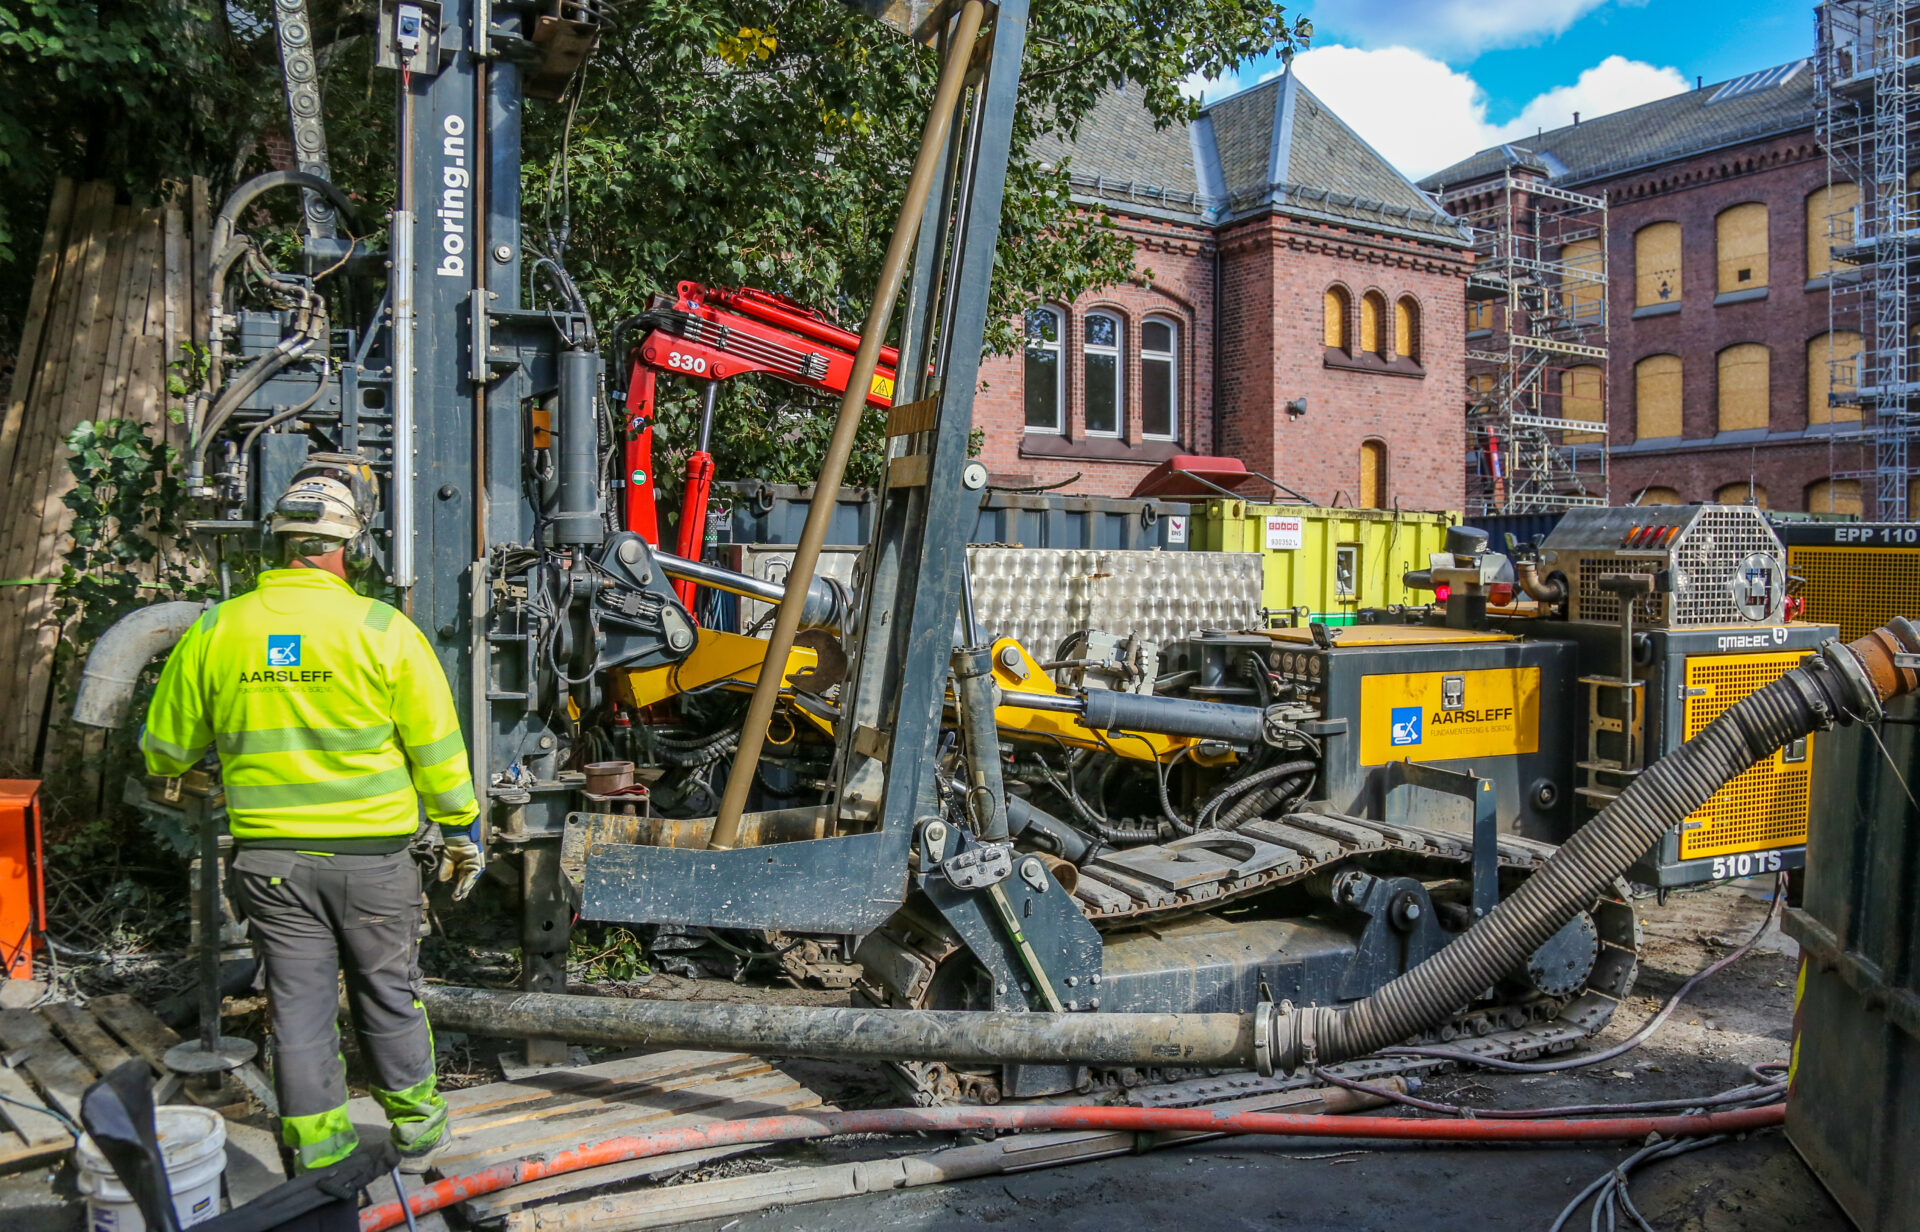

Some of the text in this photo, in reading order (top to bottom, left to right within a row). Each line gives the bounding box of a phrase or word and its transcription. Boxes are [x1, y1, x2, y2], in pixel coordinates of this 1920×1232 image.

[437, 114, 470, 277] boring.no
[668, 351, 706, 373] 330
[1834, 528, 1917, 543] EPP 110
[1718, 634, 1770, 652] qmatec
[239, 670, 333, 683] AARSLEFF
[1431, 707, 1513, 725] AARSLEFF
[1430, 726, 1485, 736] FUNDAMENTERING
[1712, 850, 1781, 879] 510 TS
